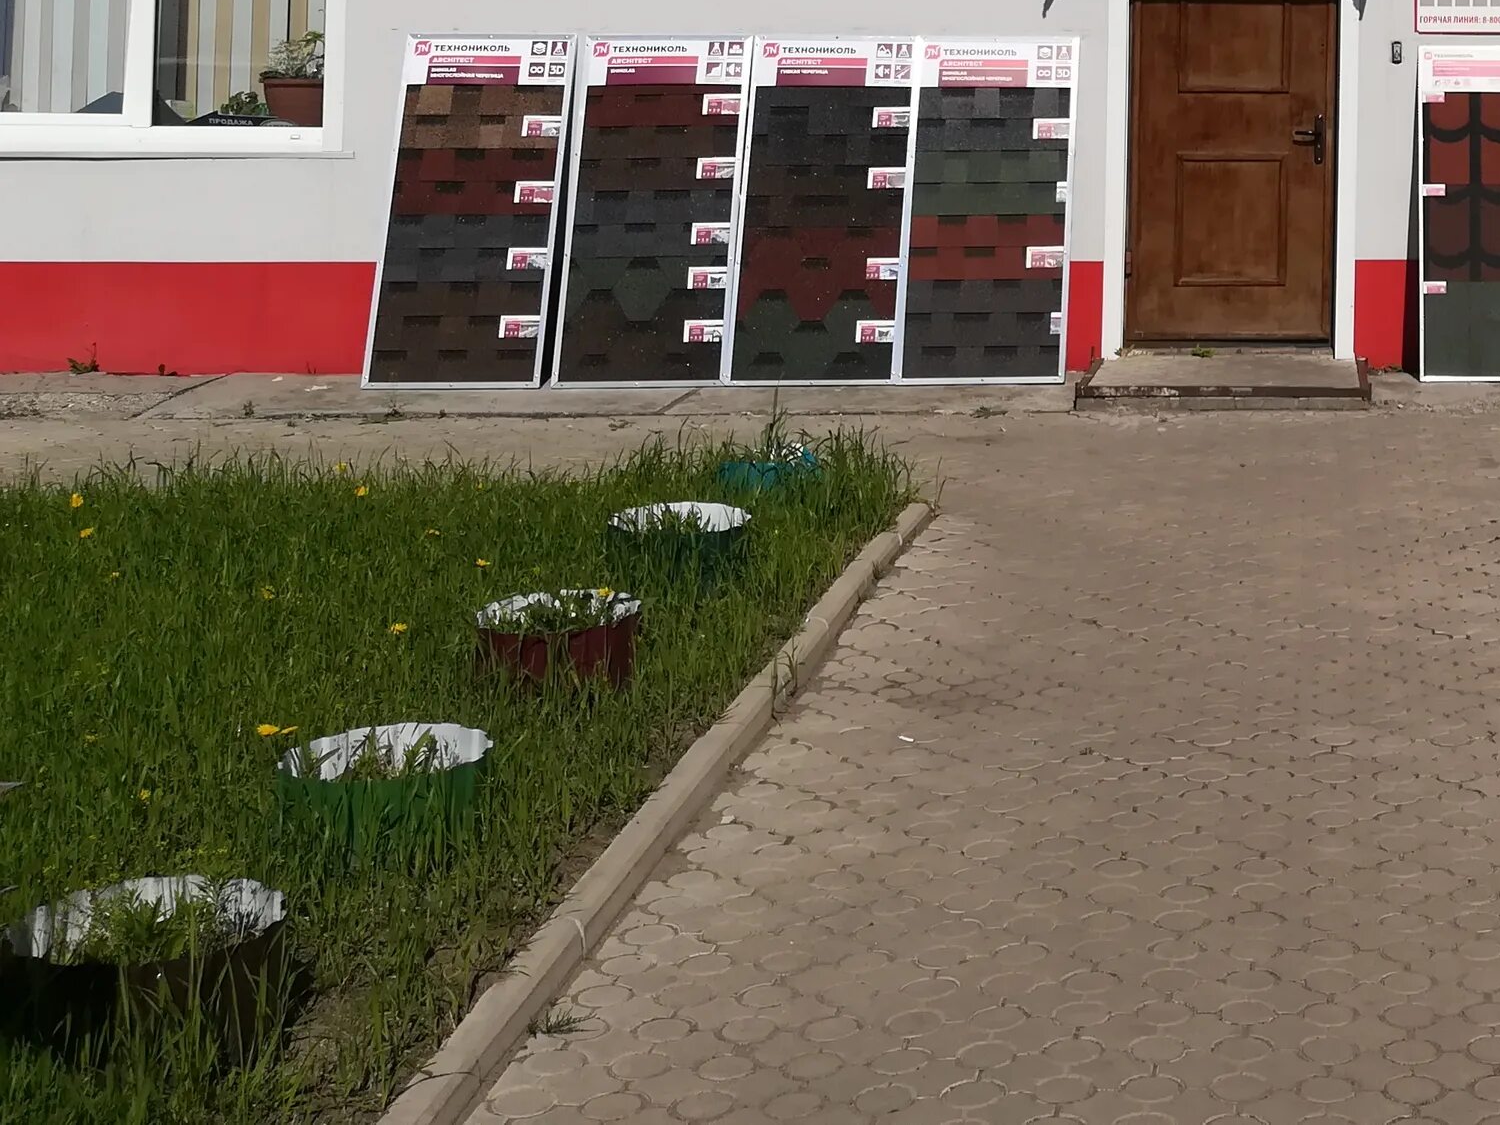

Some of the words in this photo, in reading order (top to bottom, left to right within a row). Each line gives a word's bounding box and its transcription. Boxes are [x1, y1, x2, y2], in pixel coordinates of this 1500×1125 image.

[1419, 15, 1452, 24] ГОРЯЧАЯ
[1453, 15, 1481, 24] ЛИНИЯ:
[434, 44, 511, 53] ТЕХНОНИКОЛЬ
[612, 45, 688, 53] ТЕХНОНИКОЛЬ
[782, 46, 857, 54] ТЕХНОНИКОЛЬ
[943, 48, 1017, 57] ТЕХНОНИКОЛЬ
